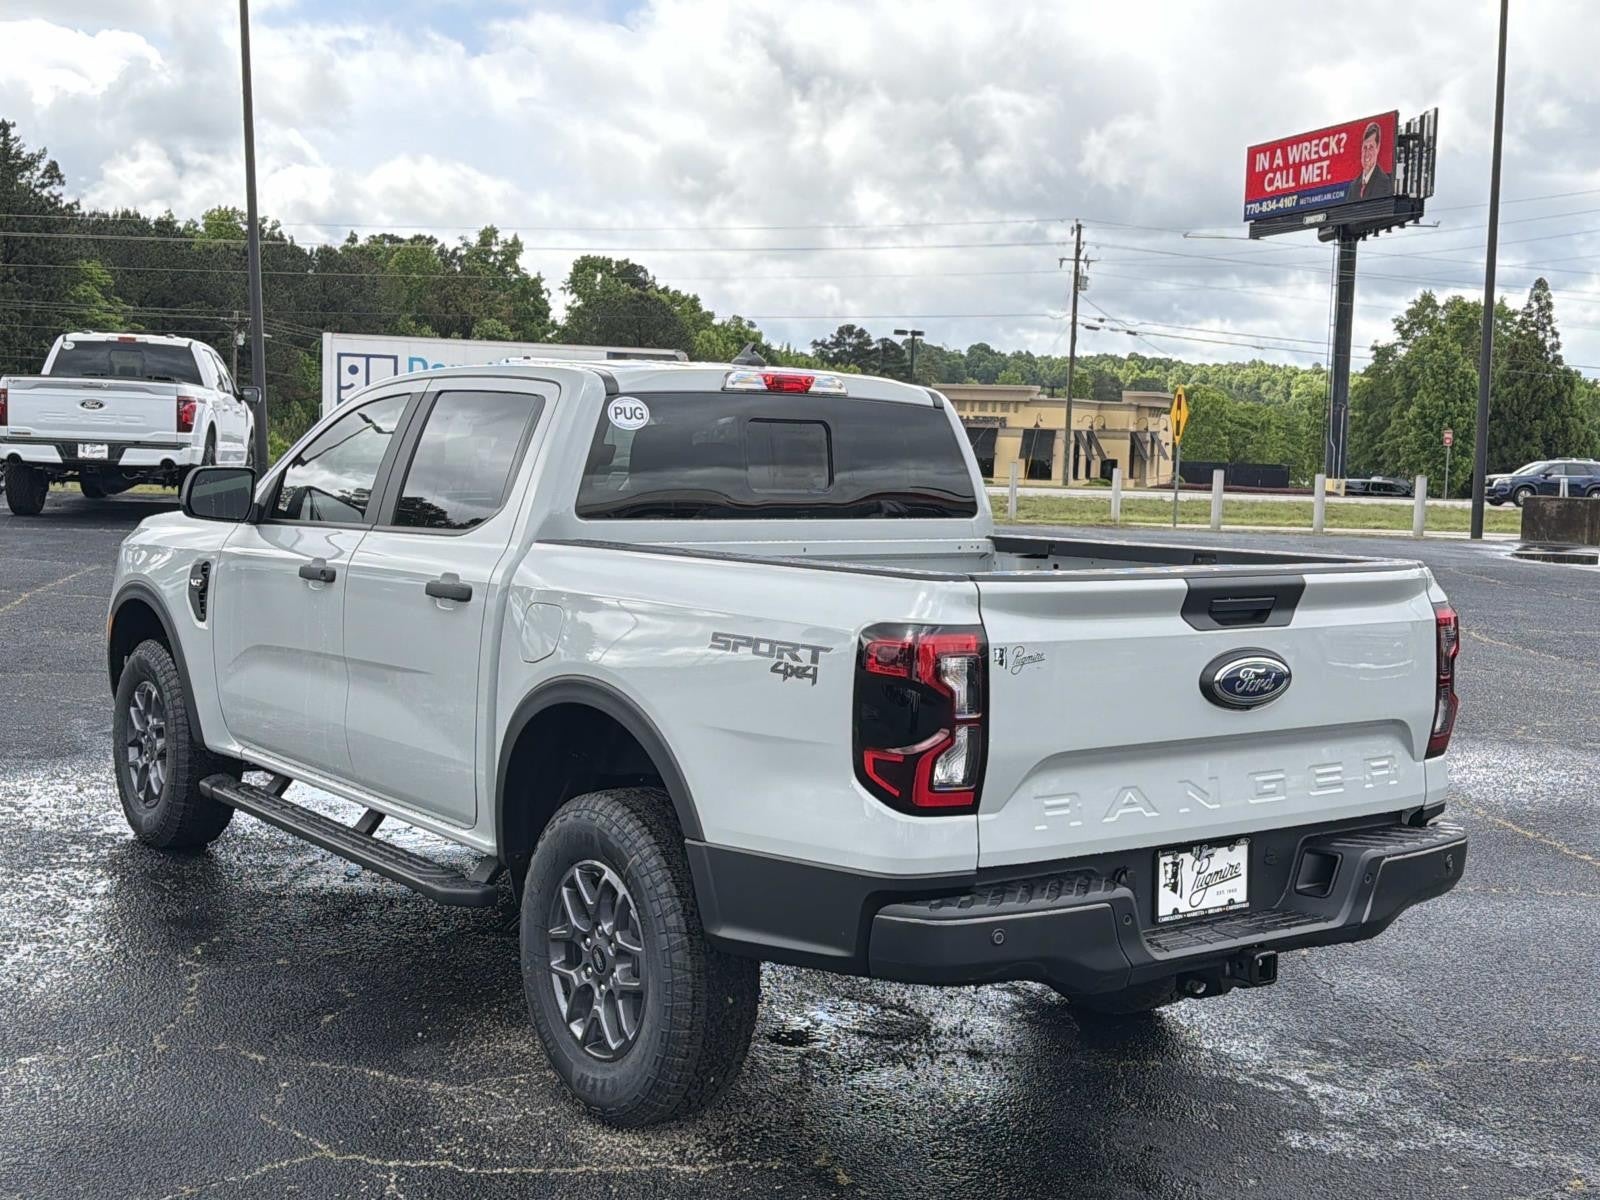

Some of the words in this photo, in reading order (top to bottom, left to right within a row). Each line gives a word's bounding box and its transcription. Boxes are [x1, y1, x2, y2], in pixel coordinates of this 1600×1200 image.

[1256, 152, 1269, 172] IN
[1272, 149, 1283, 168] A
[1288, 133, 1348, 164] WRECK?
[1264, 170, 1296, 192] CALL
[1300, 162, 1331, 184] MET.
[1246, 196, 1297, 215] 770-834-4107
[614, 407, 644, 420] PUG
[708, 632, 833, 665] SPORT
[770, 661, 817, 687] 4x4
[1235, 667, 1275, 693] Ford
[1034, 756, 1397, 831] RANGER
[1189, 854, 1242, 908] Pugmire
